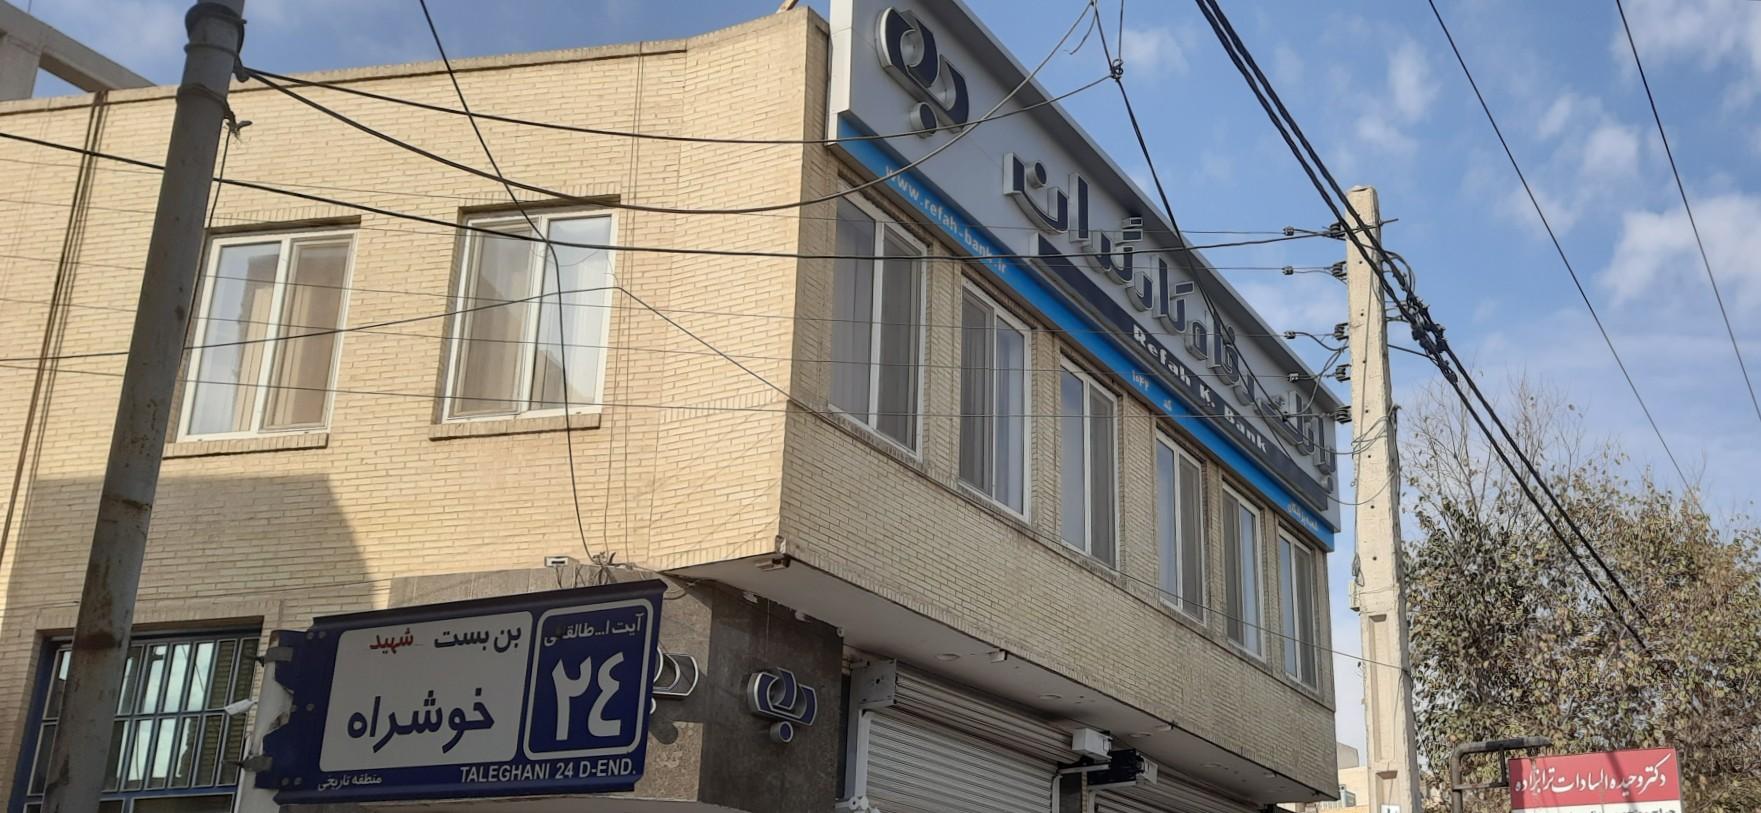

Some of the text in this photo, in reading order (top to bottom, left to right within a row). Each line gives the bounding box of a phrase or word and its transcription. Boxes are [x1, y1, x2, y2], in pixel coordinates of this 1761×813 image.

[1133, 324, 1267, 454] Refah K. Bank
[611, 612, 645, 636] آیت
[369, 626, 522, 655] بن بست شهید
[347, 687, 495, 754] خوشراه
[317, 773, 383, 792] منطقه تاریخی
[460, 757, 637, 783] TALEGHANI 24 D-END.
[1638, 752, 1672, 795] دکتر
